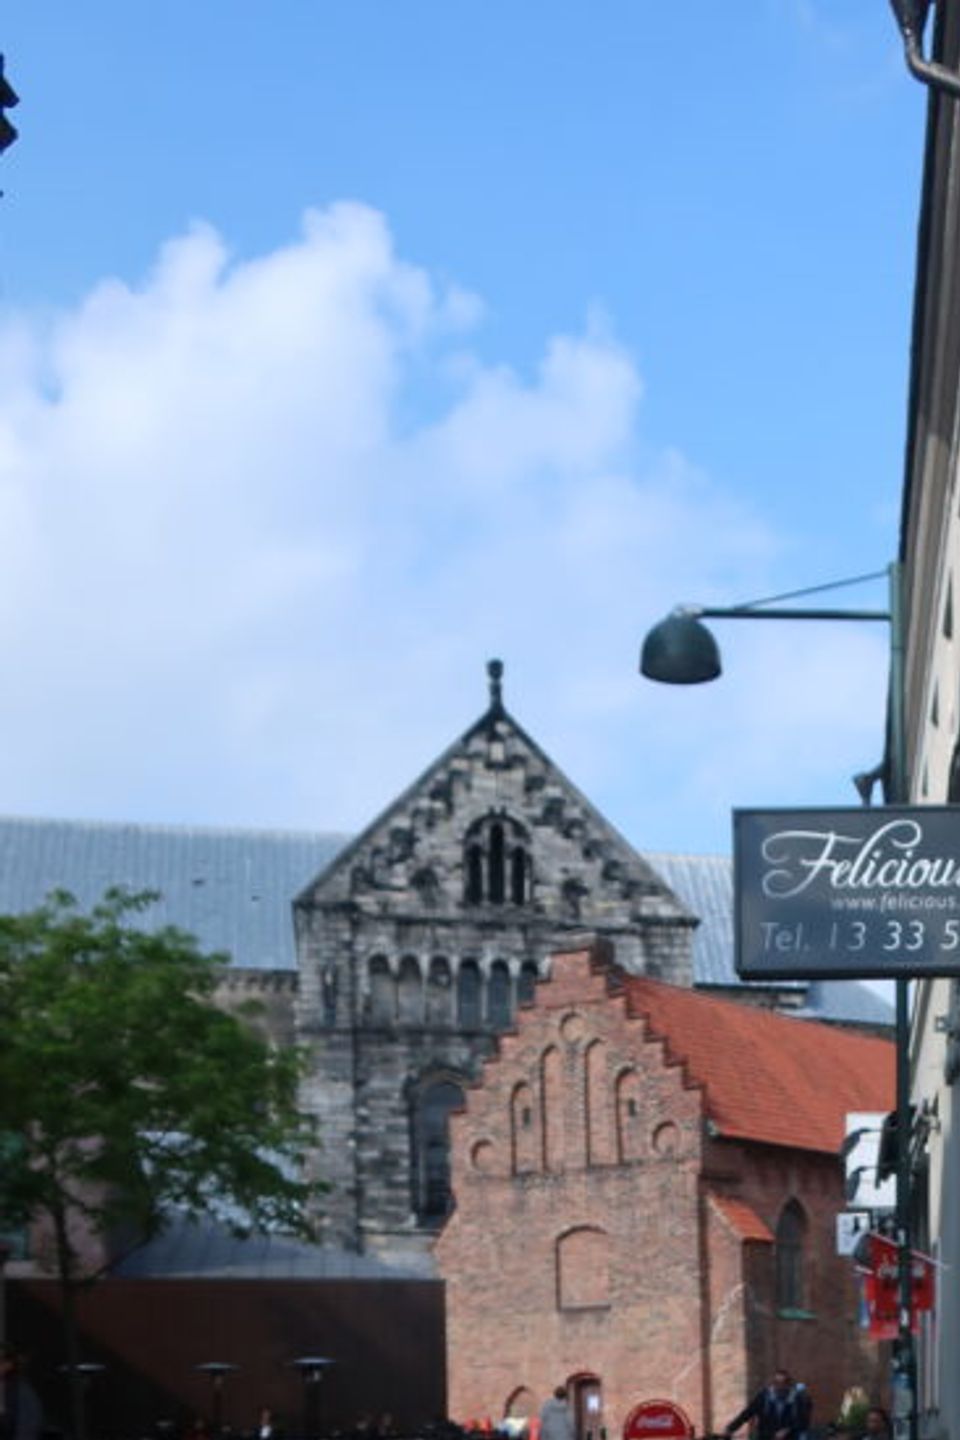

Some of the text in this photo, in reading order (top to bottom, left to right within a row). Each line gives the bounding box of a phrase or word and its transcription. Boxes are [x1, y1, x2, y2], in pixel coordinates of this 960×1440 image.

[760, 922, 810, 951] Tel.
[829, 921, 866, 951] 13
[883, 920, 925, 951] 33
